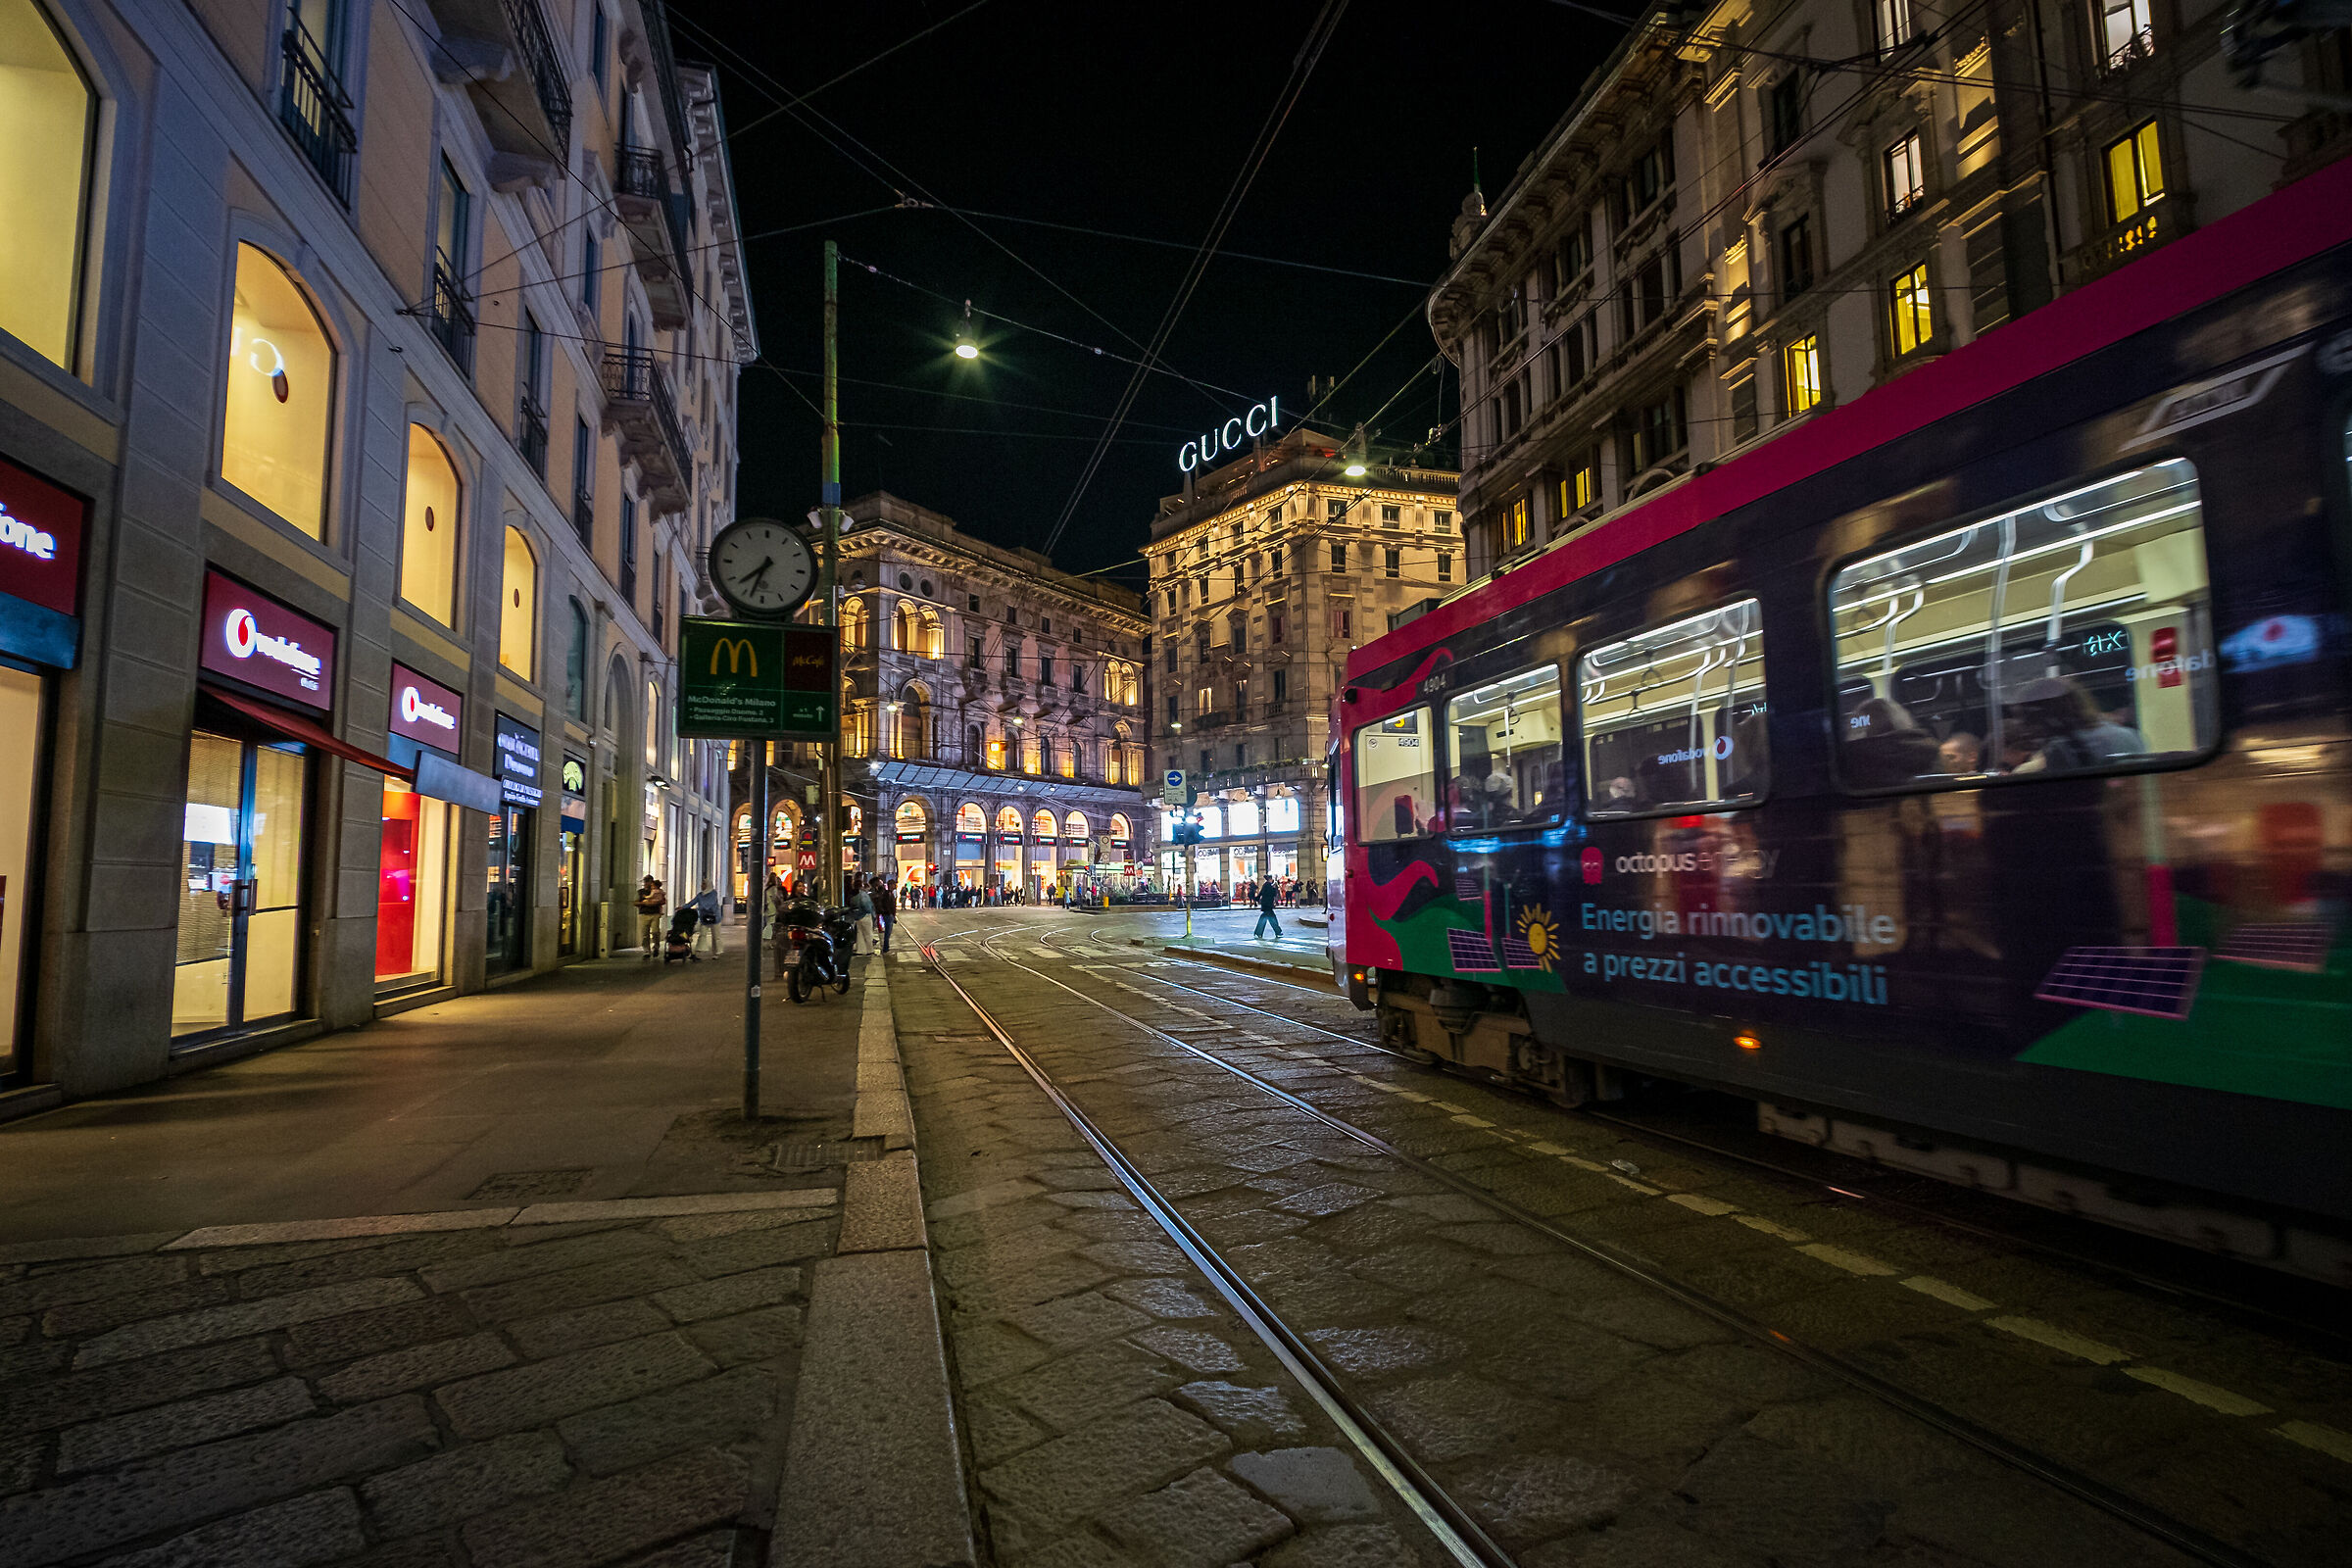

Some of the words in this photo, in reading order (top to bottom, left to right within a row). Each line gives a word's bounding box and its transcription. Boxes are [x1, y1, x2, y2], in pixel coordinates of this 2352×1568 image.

[1178, 395, 1278, 472] GUCCI
[256, 631, 321, 675] vodafone
[687, 695, 743, 706] McDonald's
[745, 698, 776, 707] Milano
[1424, 673, 1446, 694] 4904
[1397, 737, 1420, 748] 4904
[1615, 851, 1695, 879] octopus
[1581, 903, 1680, 940] Energia
[1687, 903, 1896, 945] rinnovabile
[1583, 952, 1597, 974] a
[1603, 952, 1687, 983] prezzi
[1693, 960, 1888, 1005] accessibili
